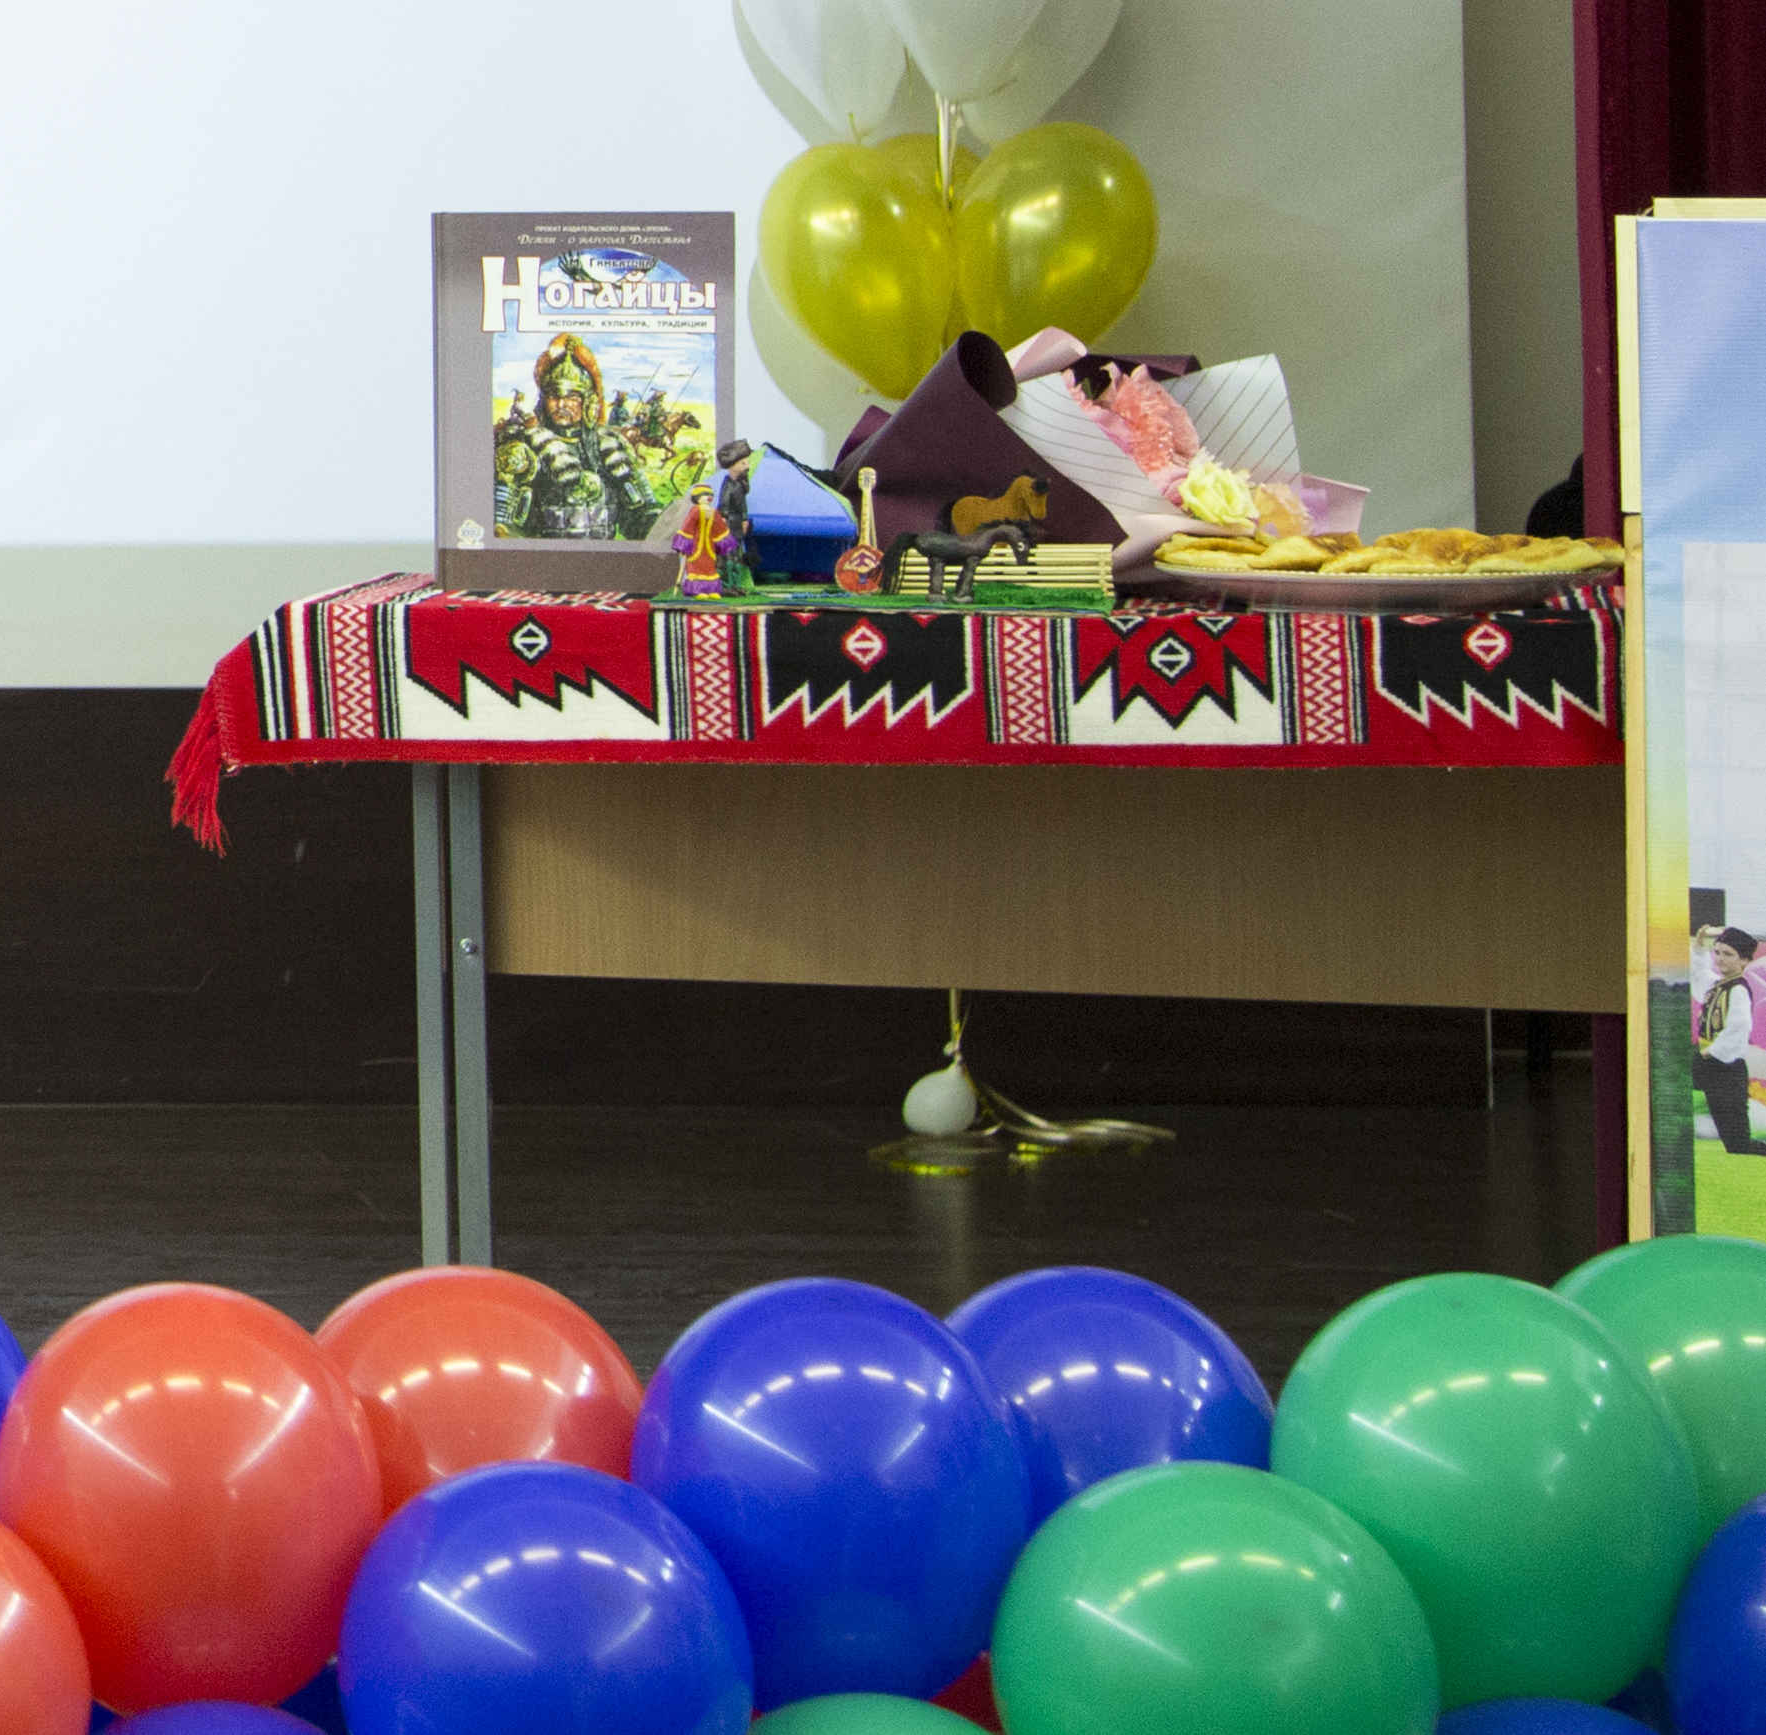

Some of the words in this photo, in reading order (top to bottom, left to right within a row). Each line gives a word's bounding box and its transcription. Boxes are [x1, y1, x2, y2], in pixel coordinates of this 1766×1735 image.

[548, 319, 595, 329] ИСТОРИЯ,
[601, 319, 650, 329] КУЛЬТУРА,
[657, 319, 708, 329] ТРАДИЦИИ
